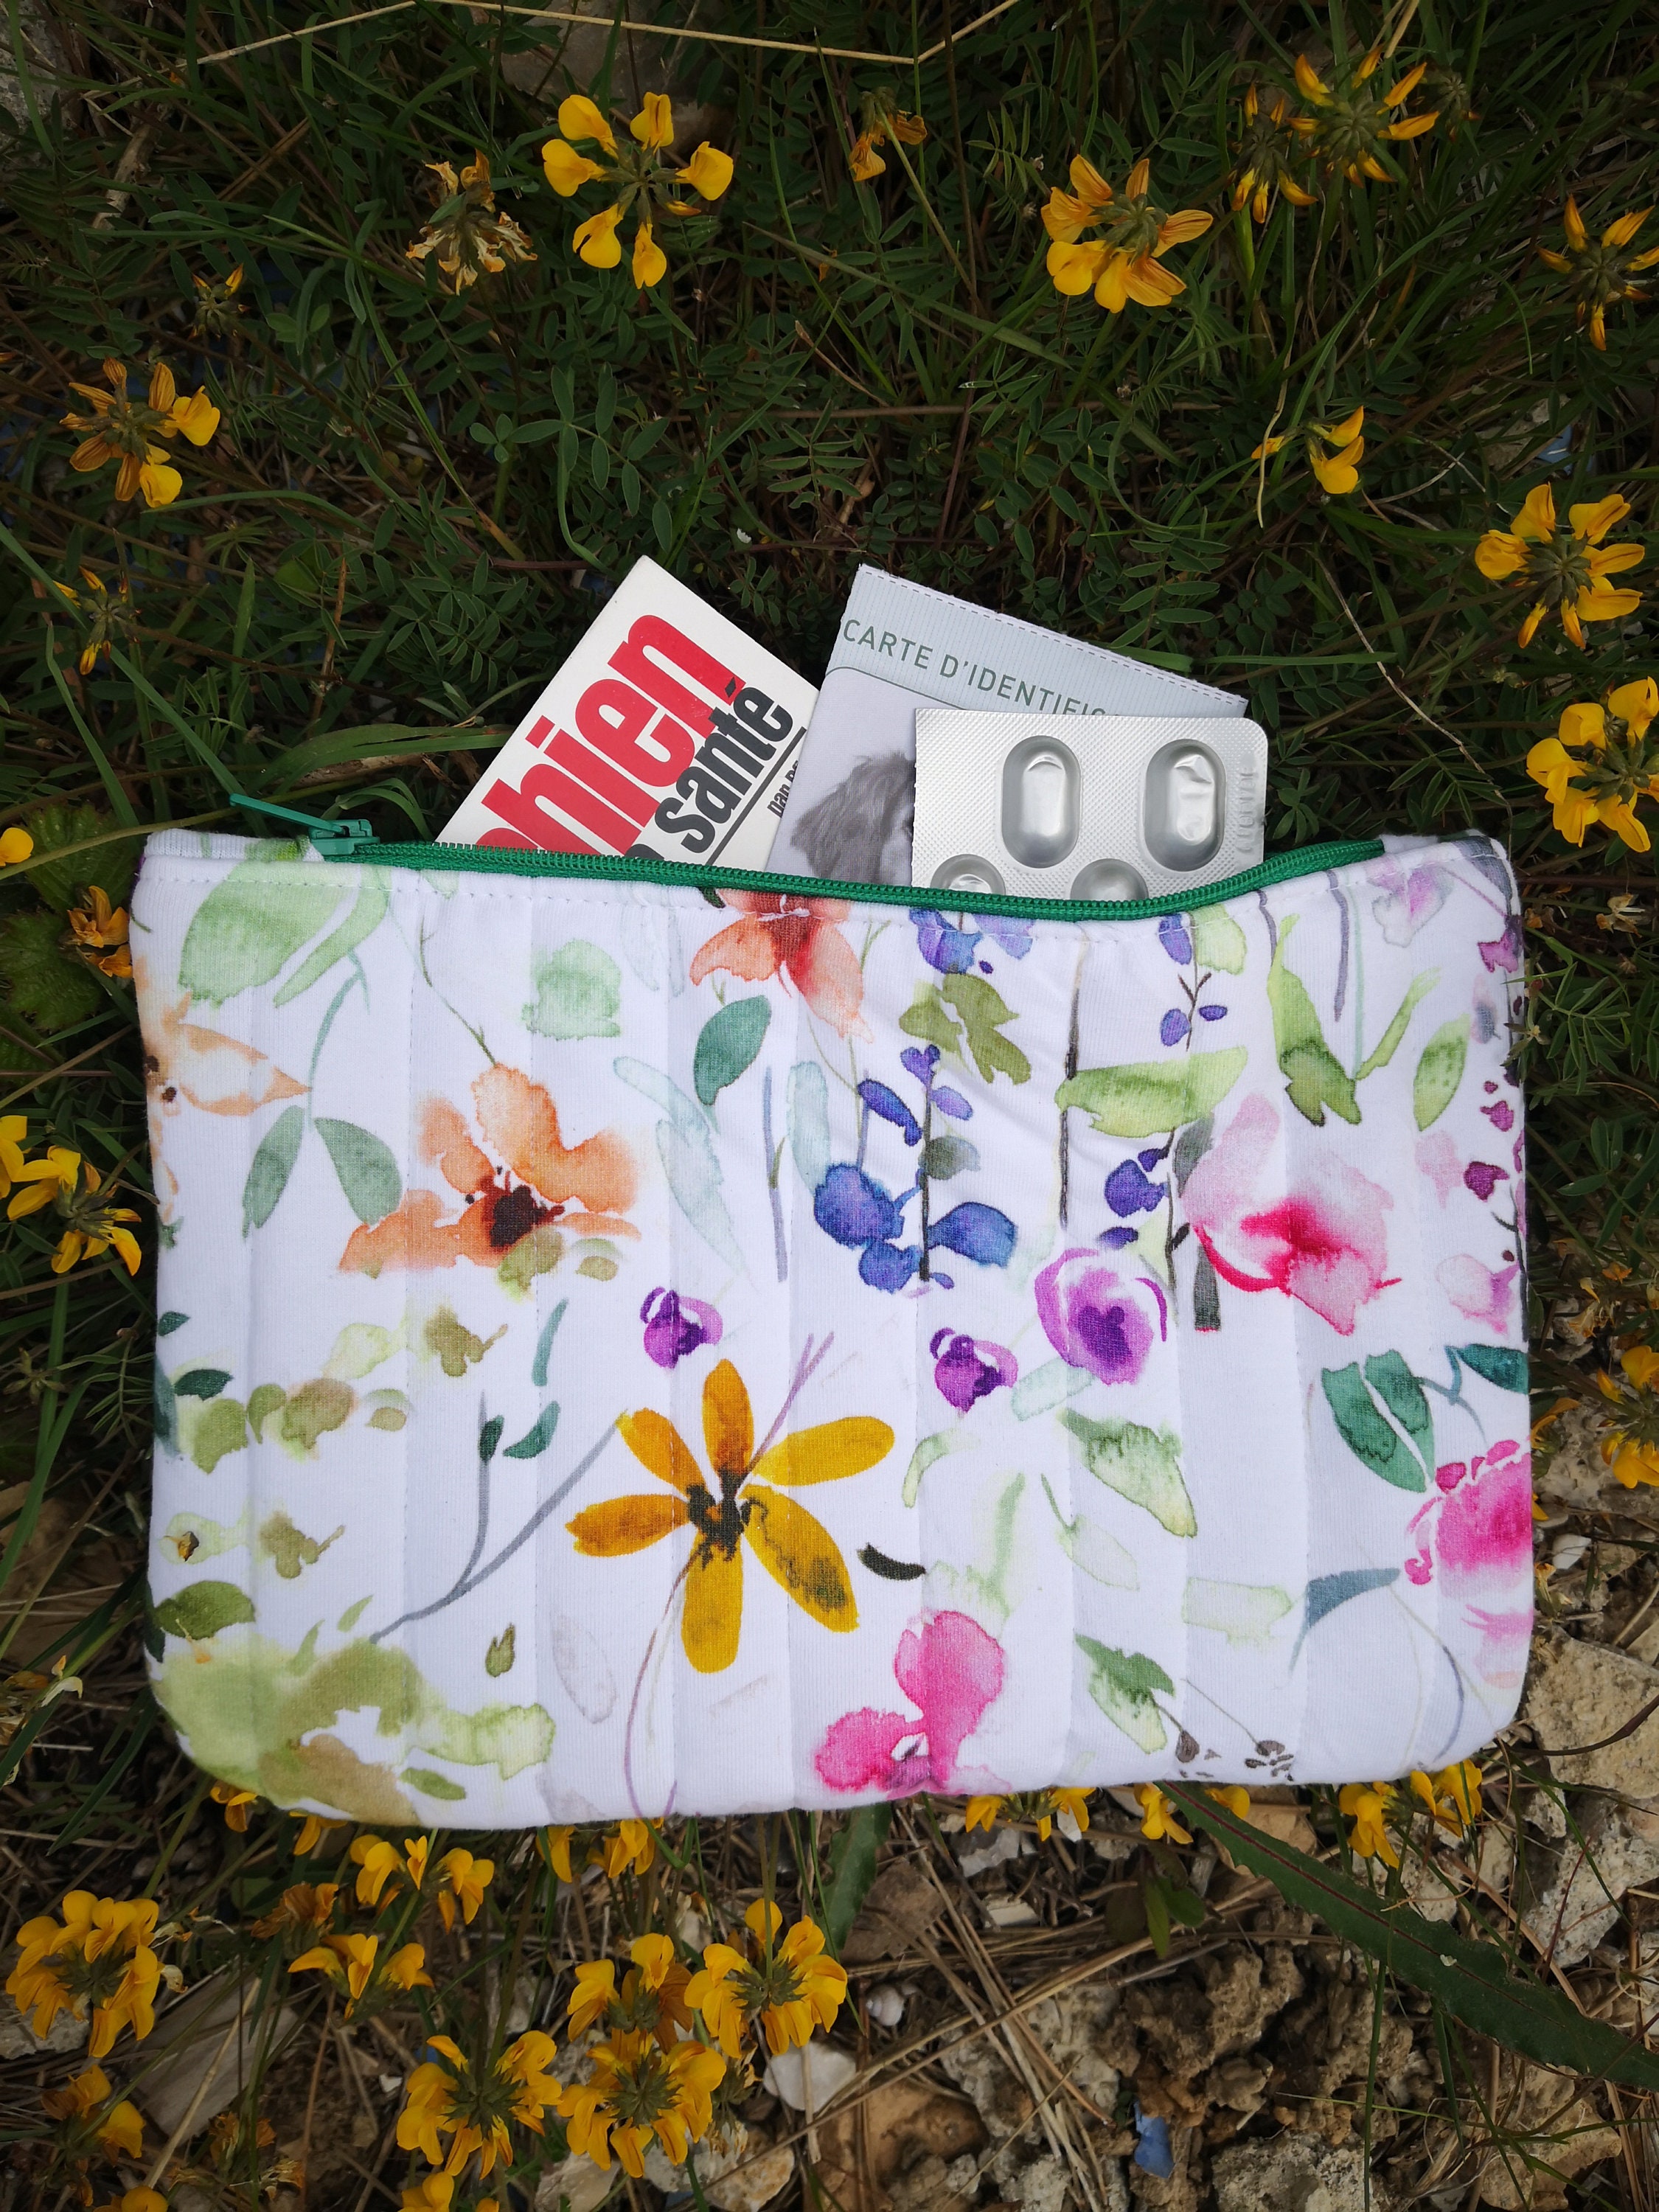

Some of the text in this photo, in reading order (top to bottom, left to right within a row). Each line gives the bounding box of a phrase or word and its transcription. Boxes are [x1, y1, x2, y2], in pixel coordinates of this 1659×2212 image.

[842, 619, 1119, 716] CARTE D'IDENTIFI
[654, 676, 794, 854] santé
